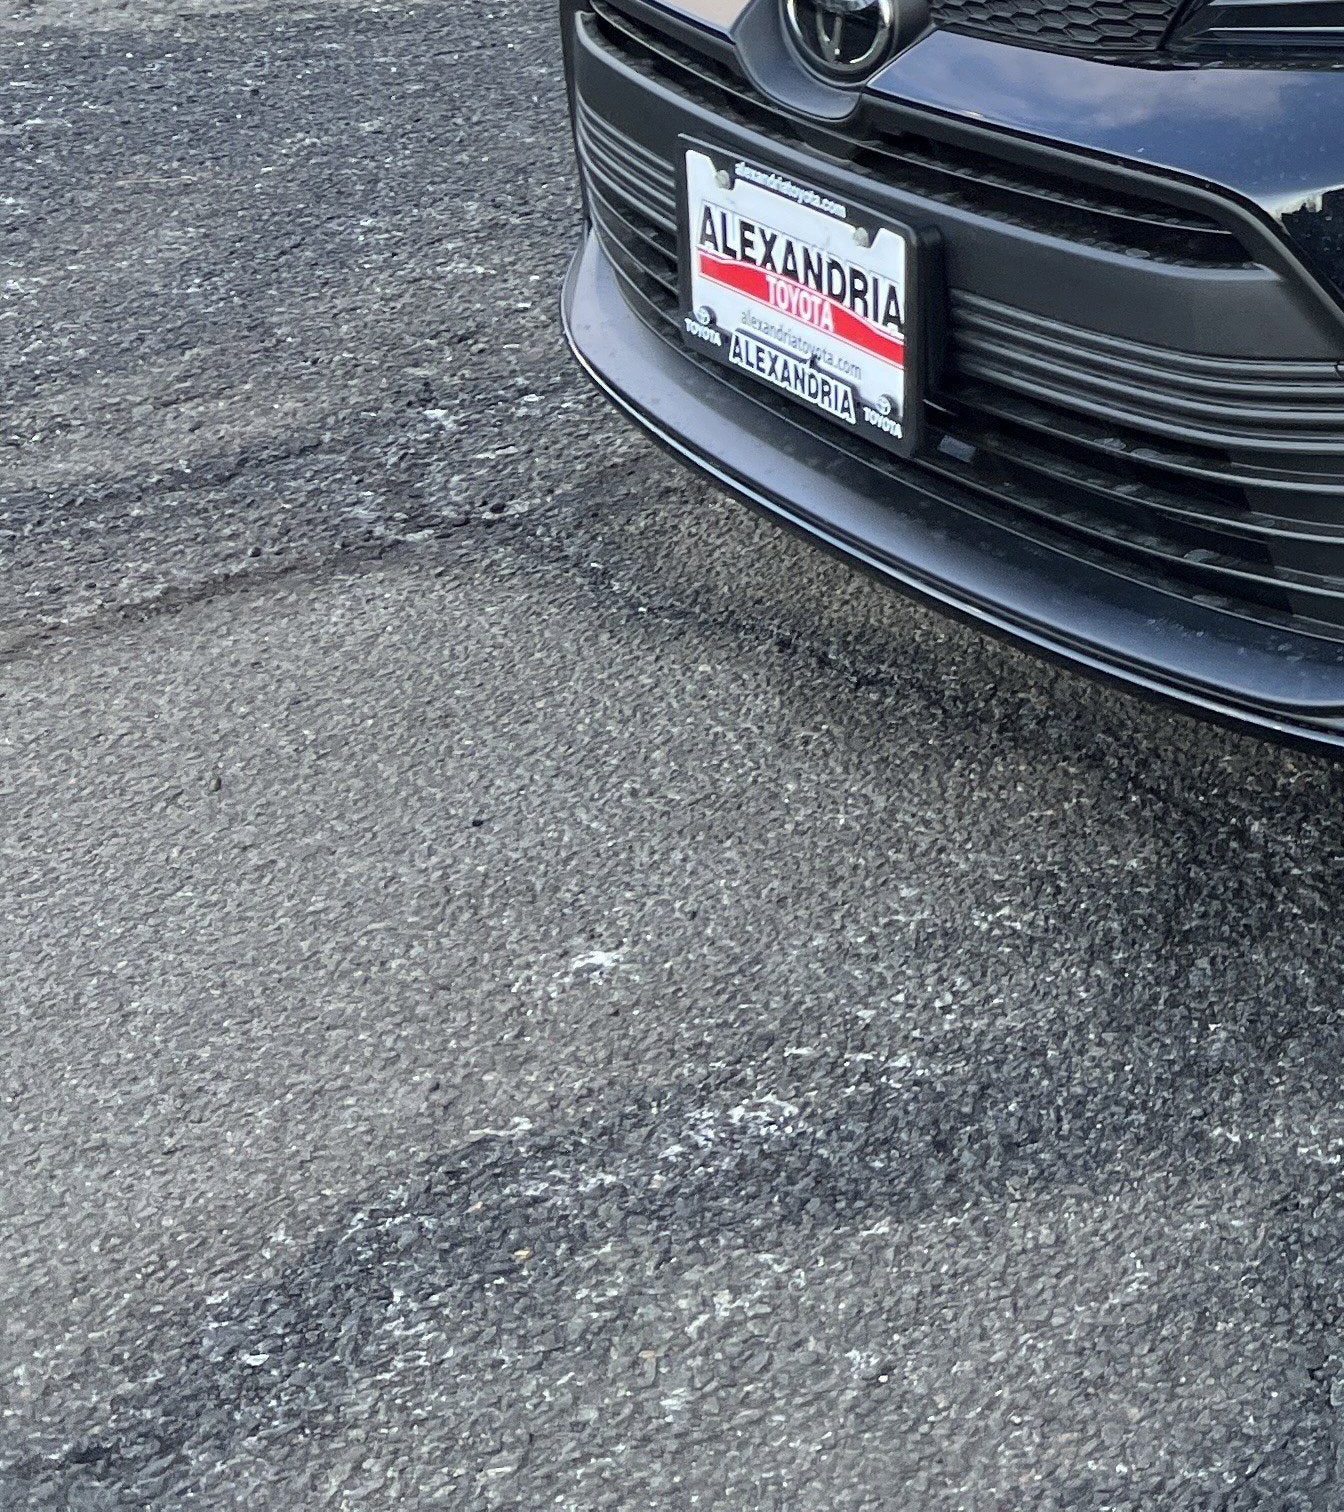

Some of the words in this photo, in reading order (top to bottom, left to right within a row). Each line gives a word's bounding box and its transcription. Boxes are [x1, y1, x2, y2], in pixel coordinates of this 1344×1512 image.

[699, 204, 904, 330] ALEXANDRIA
[684, 317, 722, 347] TOYOTA
[765, 274, 835, 333] TOYOTA
[731, 334, 855, 422] ALEXANDRIA
[862, 406, 903, 439] TOYOTA
